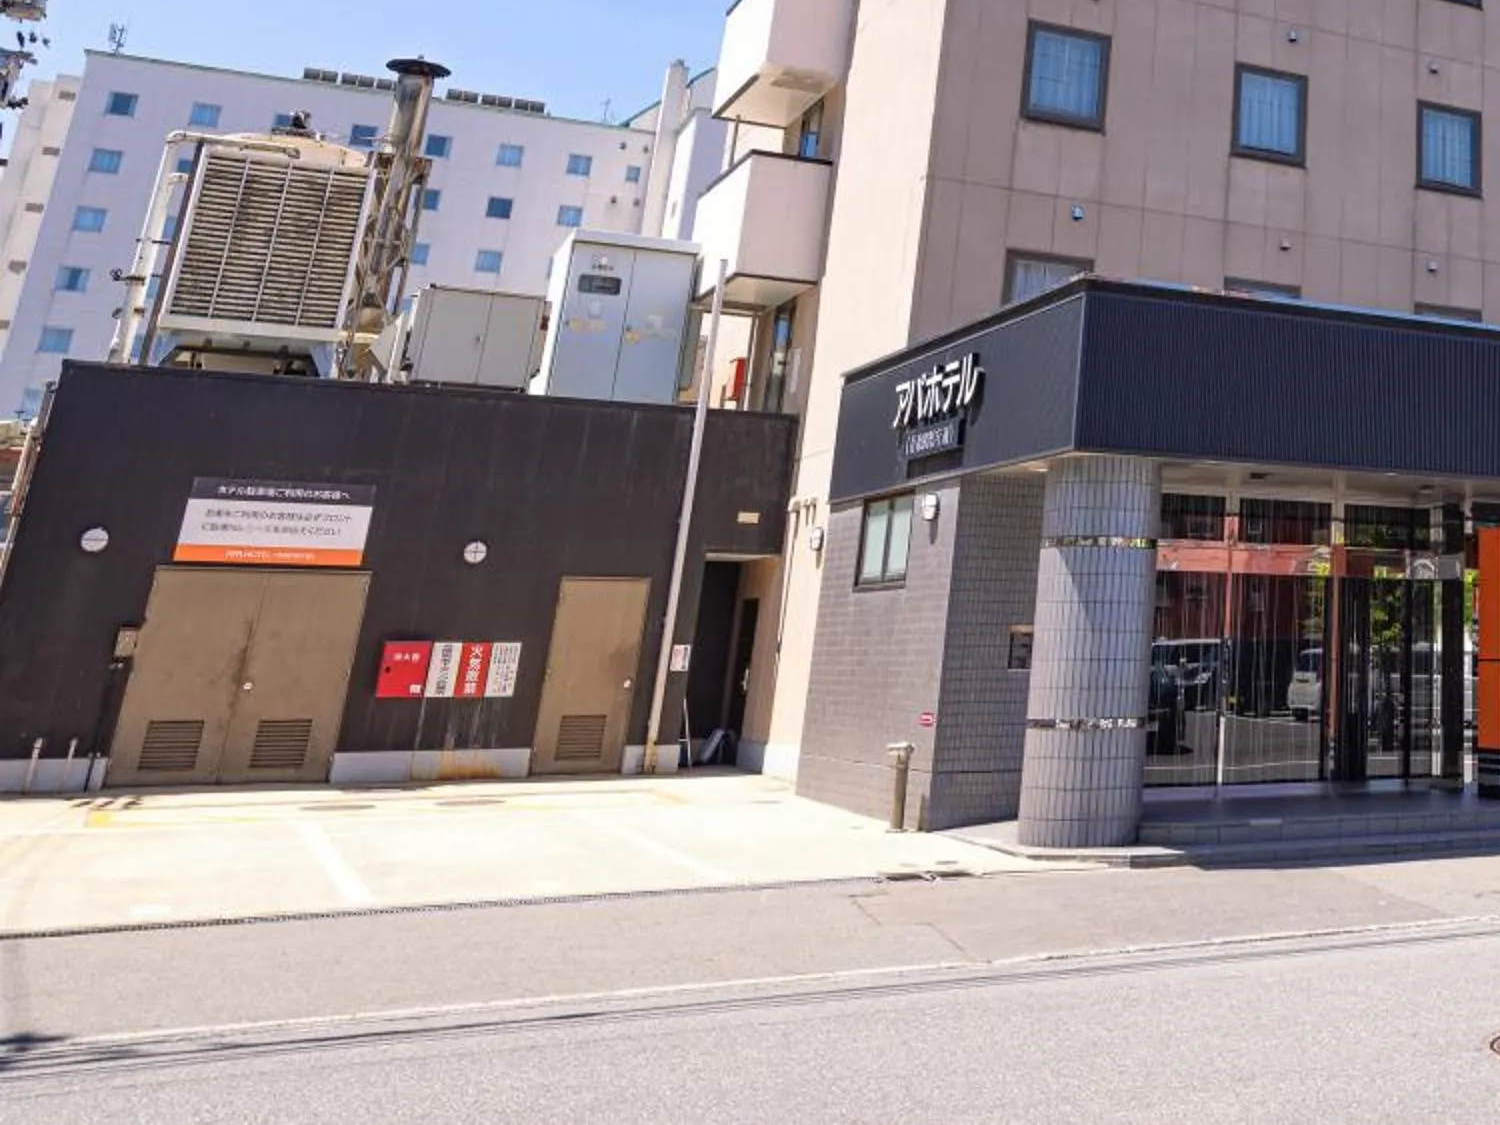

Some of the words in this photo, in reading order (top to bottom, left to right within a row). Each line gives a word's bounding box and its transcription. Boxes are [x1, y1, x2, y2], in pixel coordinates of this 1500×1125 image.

[893, 352, 985, 428] アパホテル
